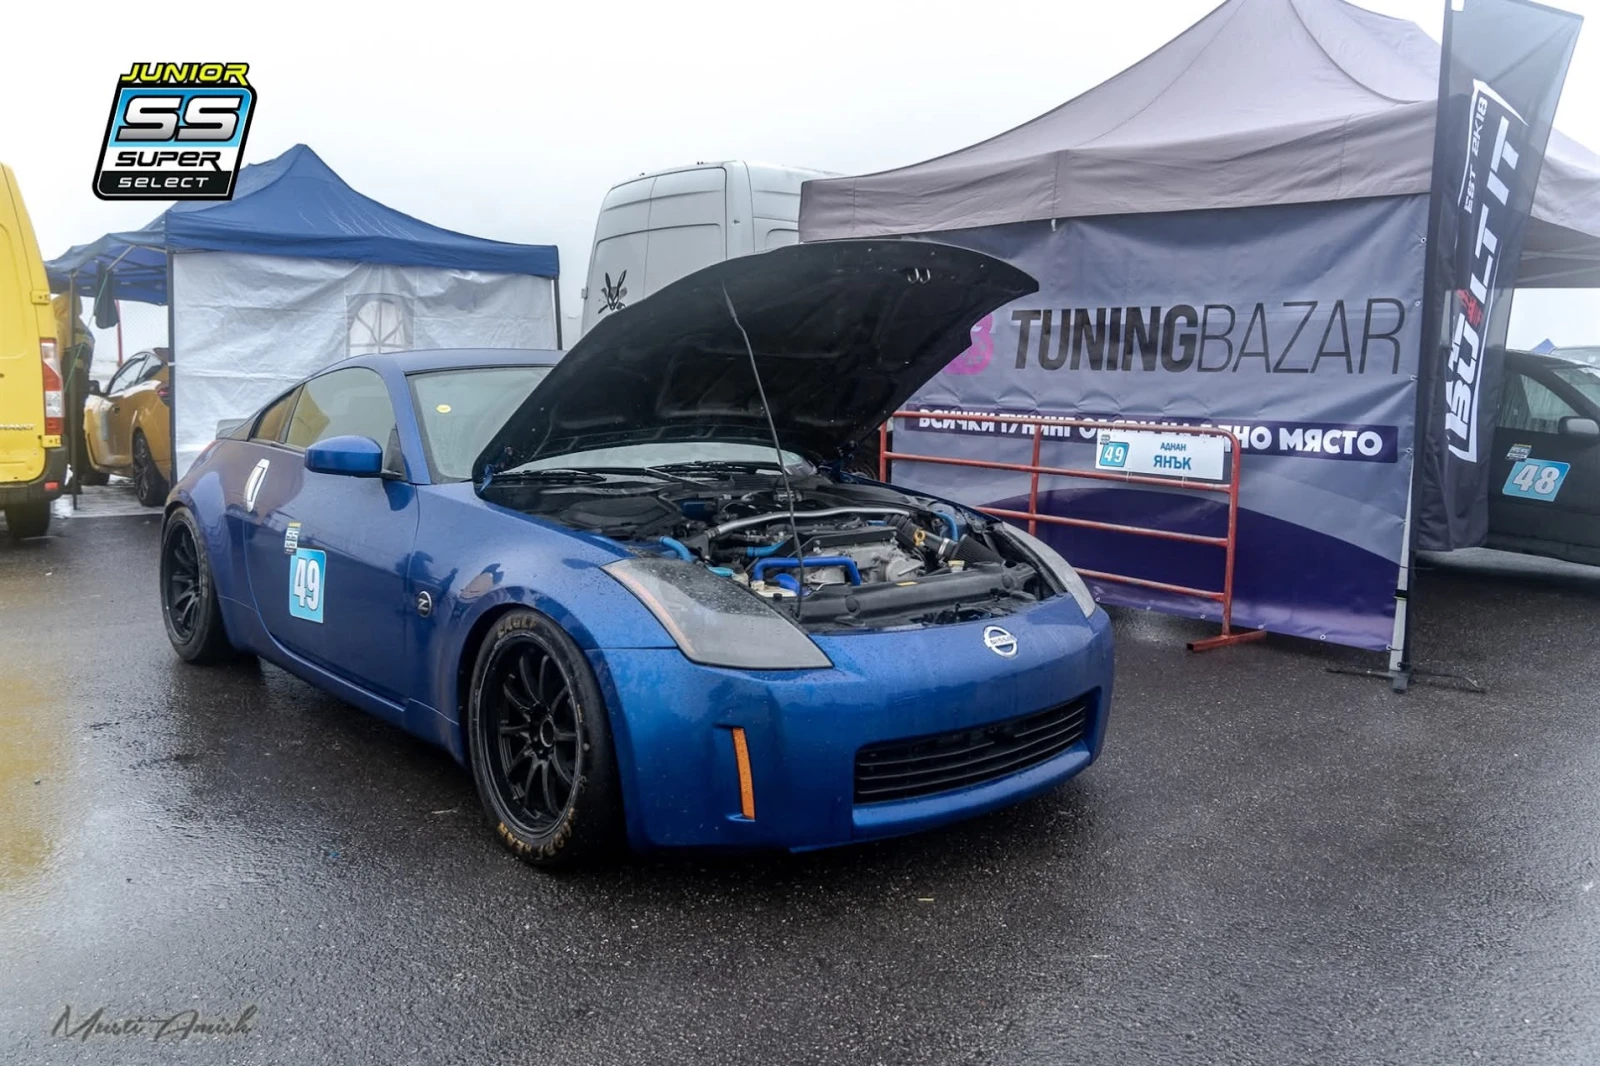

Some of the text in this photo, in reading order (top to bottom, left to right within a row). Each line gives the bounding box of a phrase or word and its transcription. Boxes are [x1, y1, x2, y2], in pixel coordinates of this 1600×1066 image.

[1011, 298, 1407, 375] TUNINGBAZAR
[1104, 446, 1125, 463] 49
[1160, 442, 1187, 451] АДНАН
[1279, 427, 1384, 457] МЯСТО
[1153, 455, 1191, 470] ЯНЪК
[1513, 464, 1560, 494] 48
[293, 558, 320, 611] 49
